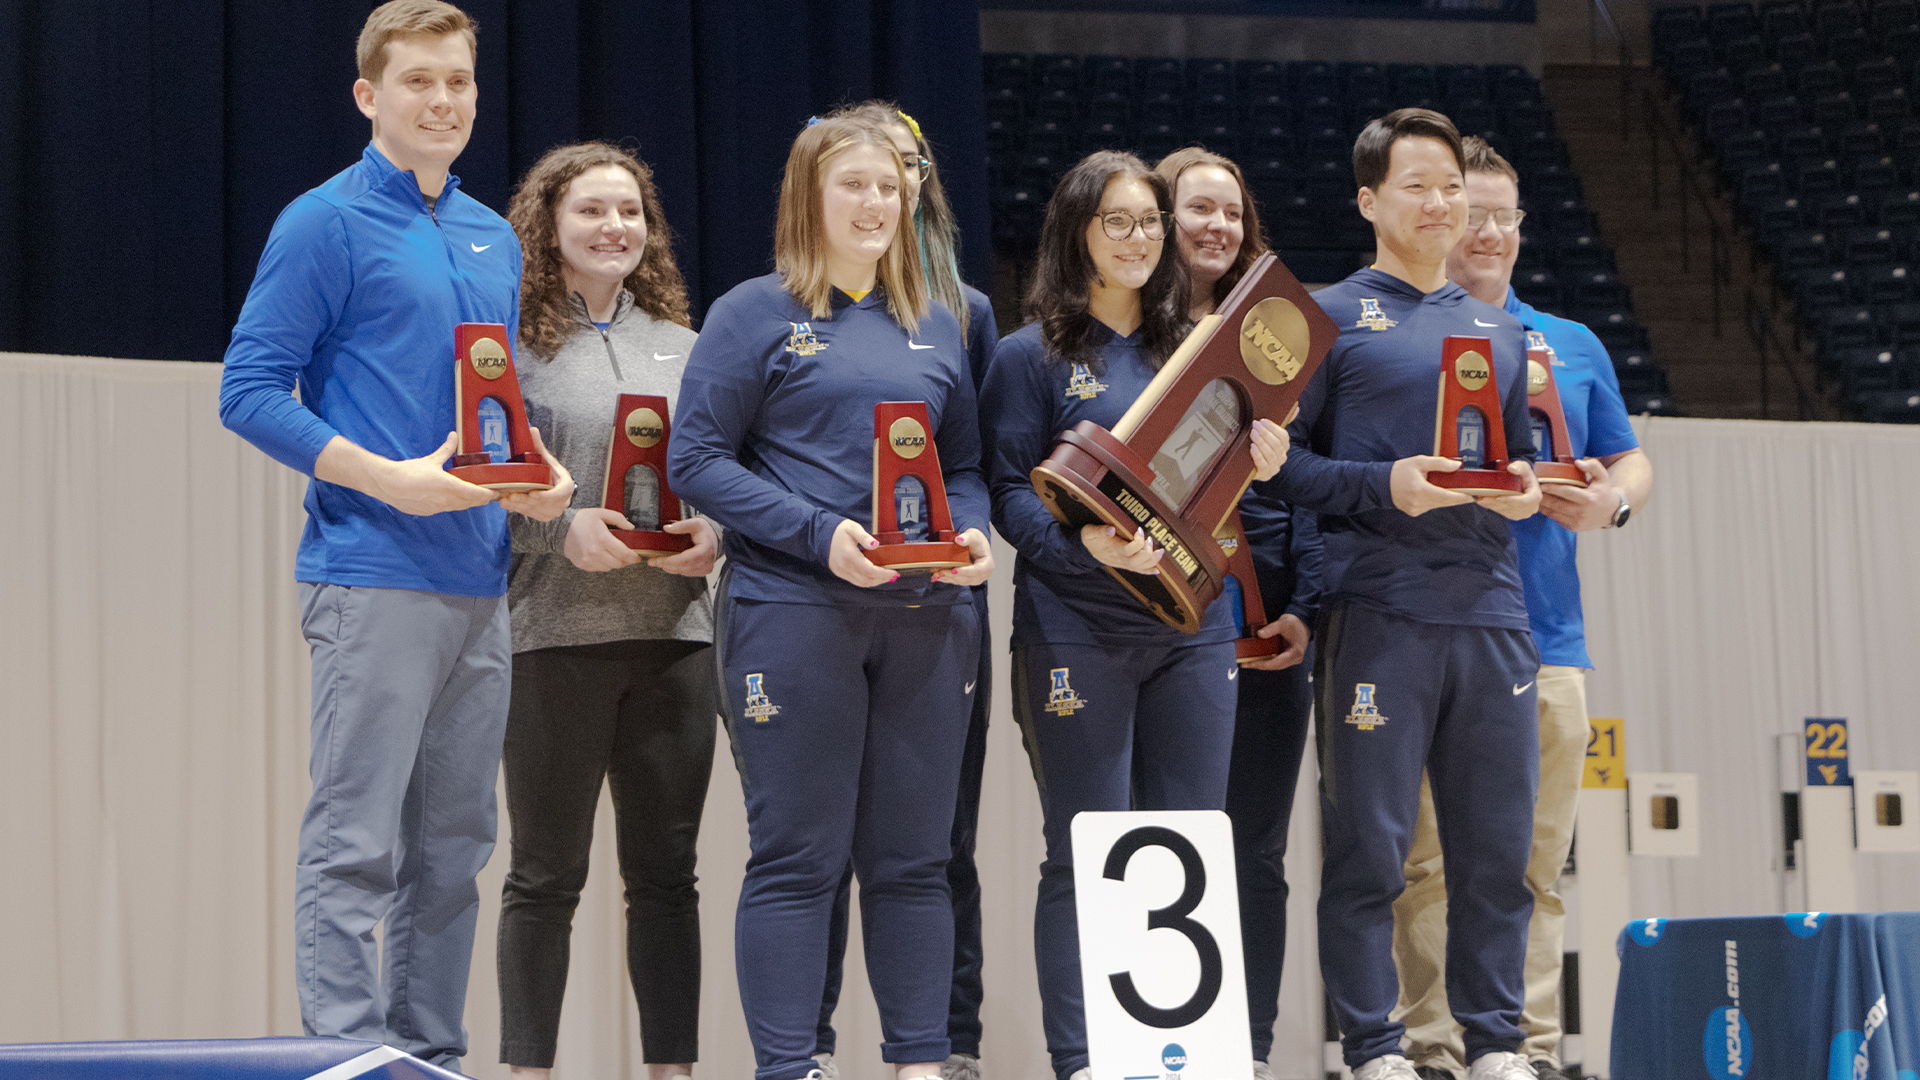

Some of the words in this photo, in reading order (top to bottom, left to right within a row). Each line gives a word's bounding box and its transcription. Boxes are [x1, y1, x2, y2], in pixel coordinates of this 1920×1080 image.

[476, 356, 506, 368] NCAA
[1244, 319, 1302, 381] NCAA
[1461, 369, 1488, 379] NCAA
[629, 426, 662, 438] NCAA
[894, 436, 925, 447] NCAA
[1116, 488, 1150, 522] THIRD
[1145, 516, 1178, 552] PLACE
[1172, 544, 1199, 576] TEAM
[1586, 726, 1615, 757] 21
[1806, 723, 1847, 758] 22
[1103, 825, 1223, 1029] 3
[1725, 940, 1743, 1076] NCAA.com
[1163, 1056, 1187, 1065] NCAA
